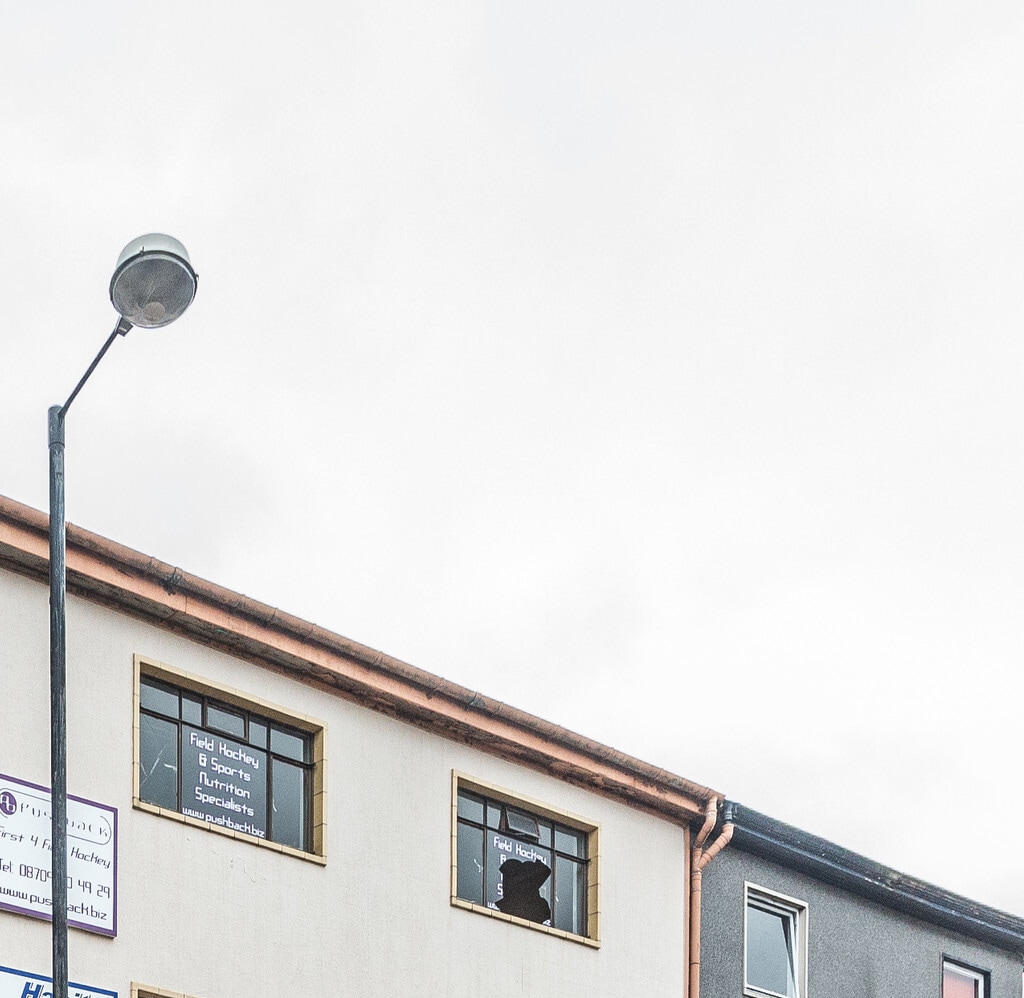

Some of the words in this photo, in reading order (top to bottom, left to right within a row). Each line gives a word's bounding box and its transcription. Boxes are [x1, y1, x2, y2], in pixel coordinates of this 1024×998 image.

[190, 732, 214, 752] Field
[219, 742, 259, 769] Hockey
[198, 753, 207, 766] &
[211, 758, 251, 782] Sports
[199, 772, 250, 799] Nutrition
[195, 787, 254, 817] Specialists
[31, 835, 38, 846] 4
[494, 836, 512, 852] Field
[70, 847, 111, 870] Hockey
[78, 879, 92, 894] 49
[97, 884, 110, 899] 29
[0, 886, 107, 921] www.pusack.biz
